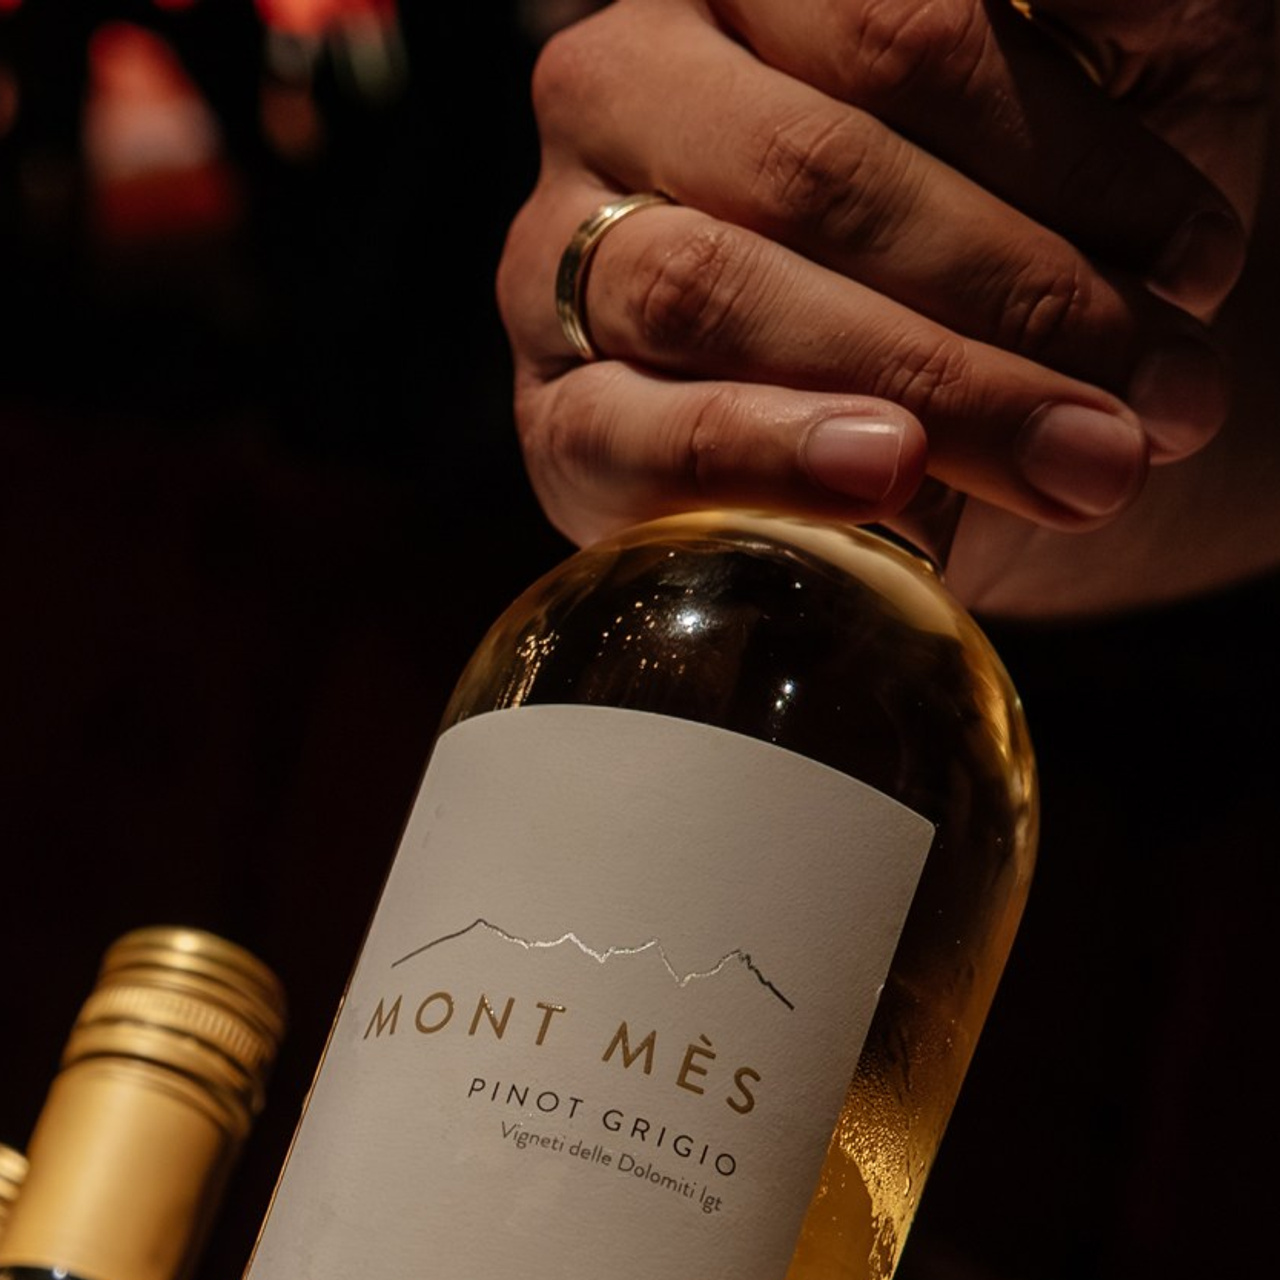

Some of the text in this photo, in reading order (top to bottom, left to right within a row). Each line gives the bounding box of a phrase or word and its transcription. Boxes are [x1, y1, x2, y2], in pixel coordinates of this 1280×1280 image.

[363, 991, 763, 1116] MONT MÈS
[467, 1077, 739, 1178] PINOT GRIGIO
[500, 1120, 566, 1152] Vigneti
[567, 1138, 613, 1168] delle
[617, 1152, 697, 1200] Dolomiti
